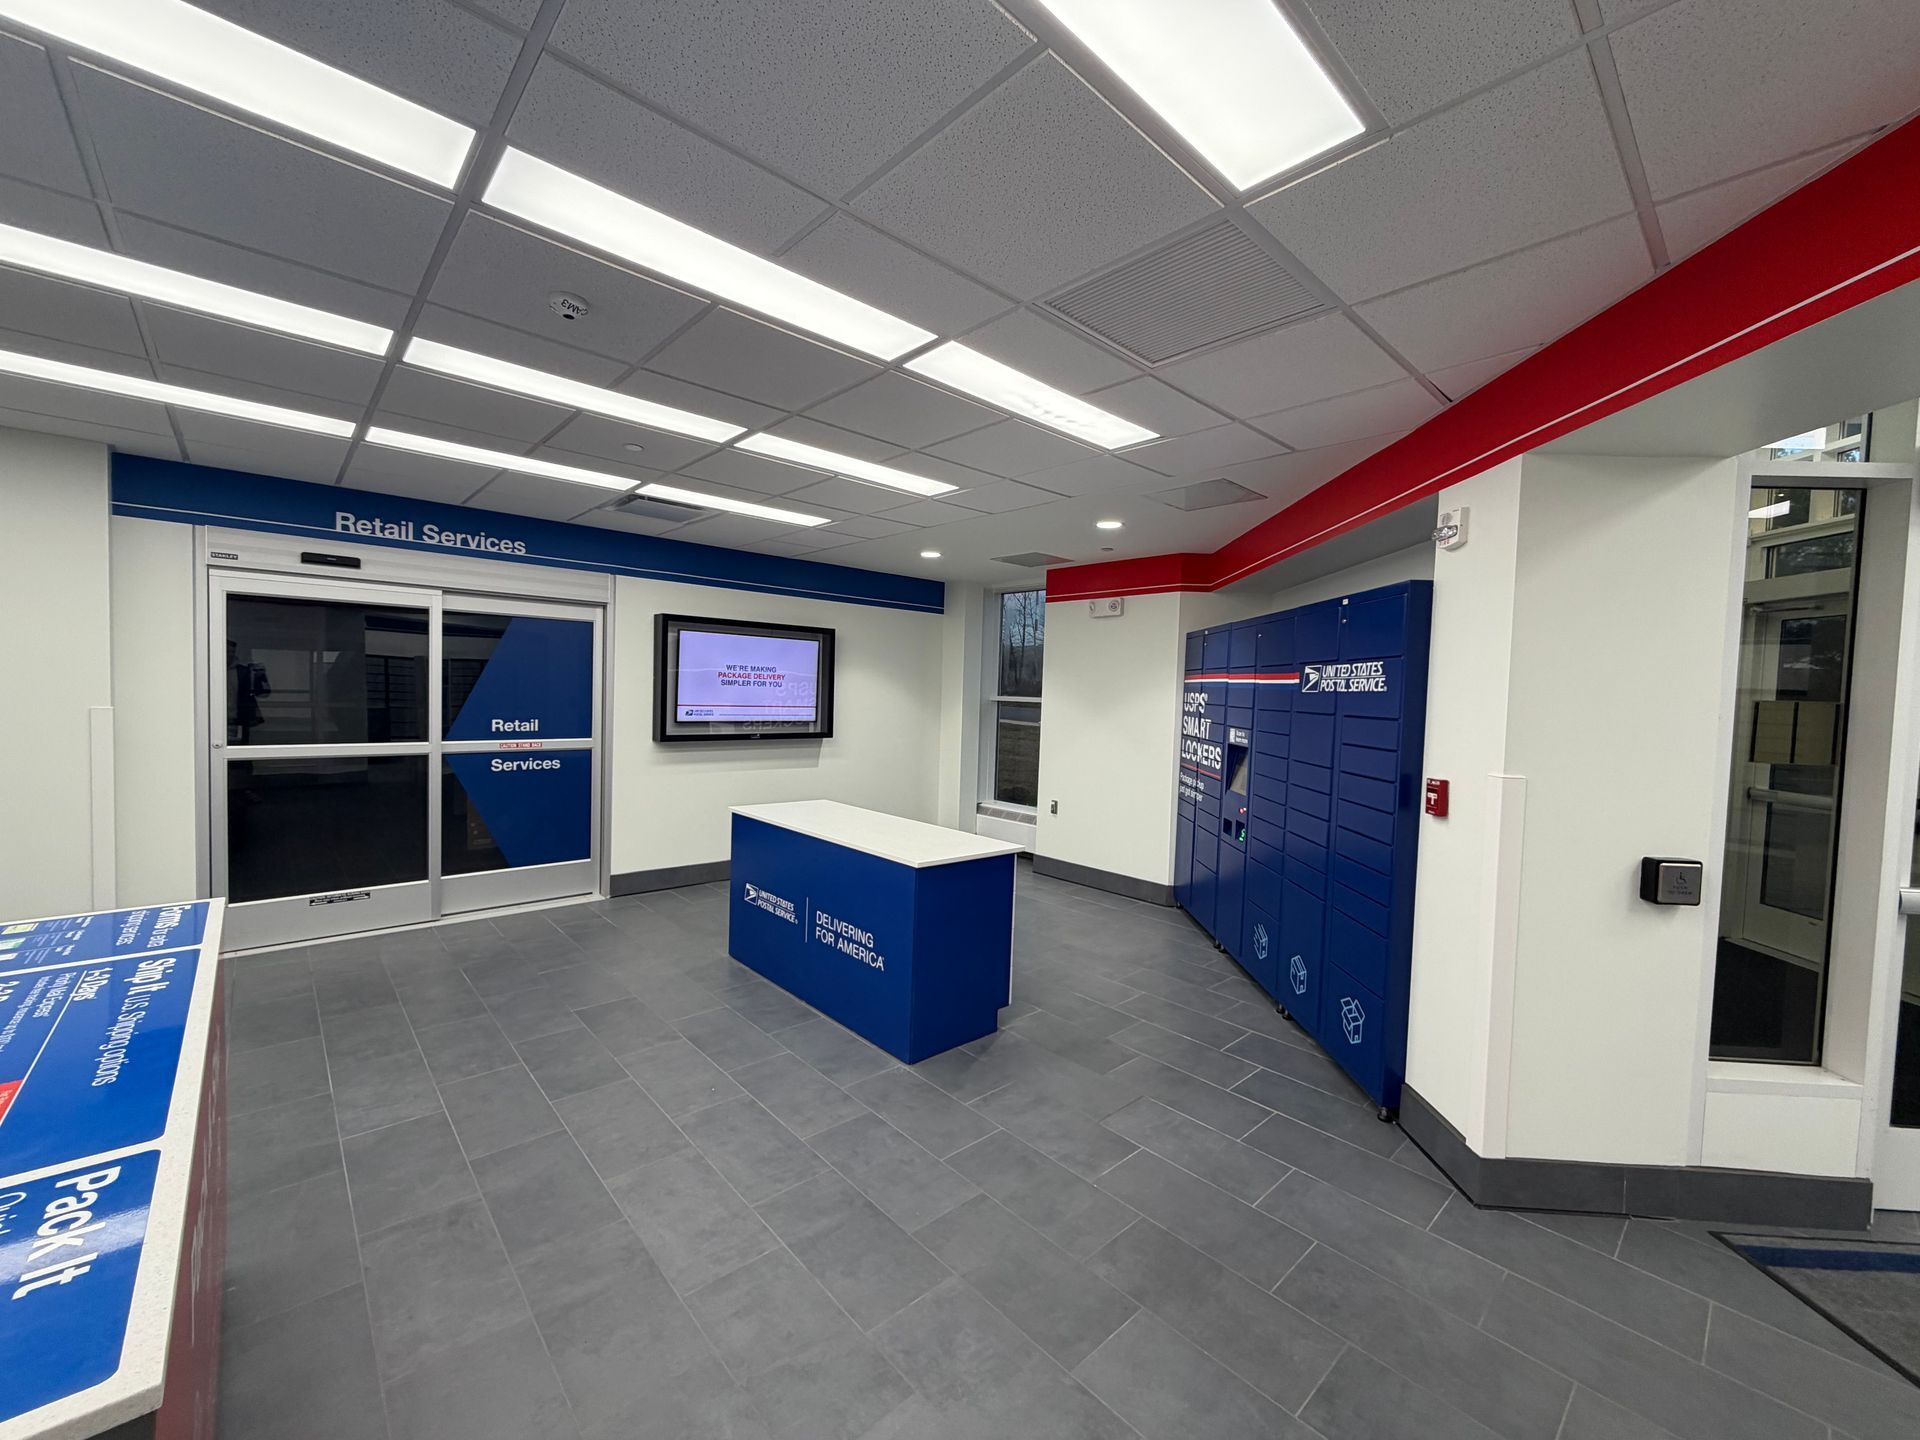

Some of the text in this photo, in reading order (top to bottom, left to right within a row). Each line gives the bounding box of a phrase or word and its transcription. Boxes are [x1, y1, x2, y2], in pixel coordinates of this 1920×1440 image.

[335, 511, 527, 555] Retail Services
[718, 671, 786, 681] PACKAGE DELIVERY
[726, 664, 777, 673] WE'RE MAKING
[1322, 661, 1384, 677] UNITED STATES
[720, 679, 751, 687] SIMPLER
[1320, 679, 1348, 692] POSTAL
[491, 719, 539, 732] Retail
[1182, 715, 1211, 740] SMART
[490, 757, 561, 772] Services
[1181, 738, 1222, 770] LOCKERS
[757, 899, 775, 914] POSTAL
[758, 889, 795, 911] UNITED STATES
[154, 905, 192, 929] Forms
[815, 926, 835, 947] FOR
[816, 910, 874, 948] DELIVERING
[123, 957, 177, 984] Ship
[127, 981, 170, 996] It
[98, 1010, 147, 1050] Shipping
[91, 1047, 130, 1087] options
[11, 1166, 122, 1300] Pack It
